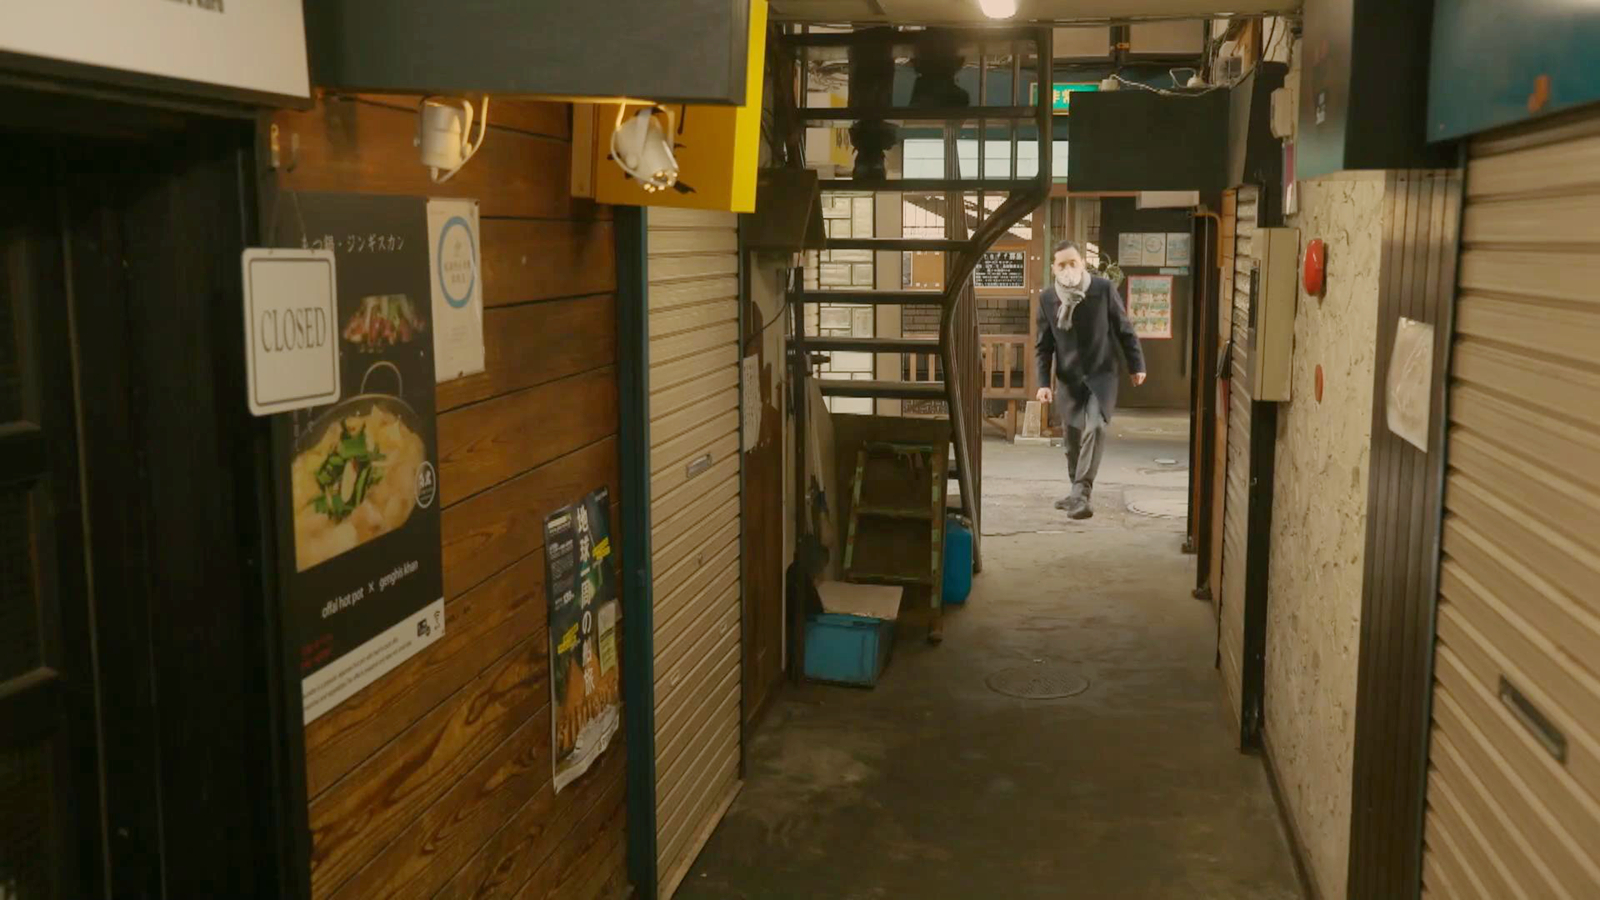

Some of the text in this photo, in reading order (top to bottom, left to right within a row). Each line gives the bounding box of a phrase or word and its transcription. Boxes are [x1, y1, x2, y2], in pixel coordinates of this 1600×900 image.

[261, 307, 326, 353] CLOSED
[322, 598, 338, 619] offal
[339, 594, 351, 610] hot
[352, 587, 364, 606] pot
[379, 567, 403, 591] genghis
[403, 560, 418, 576] khan
